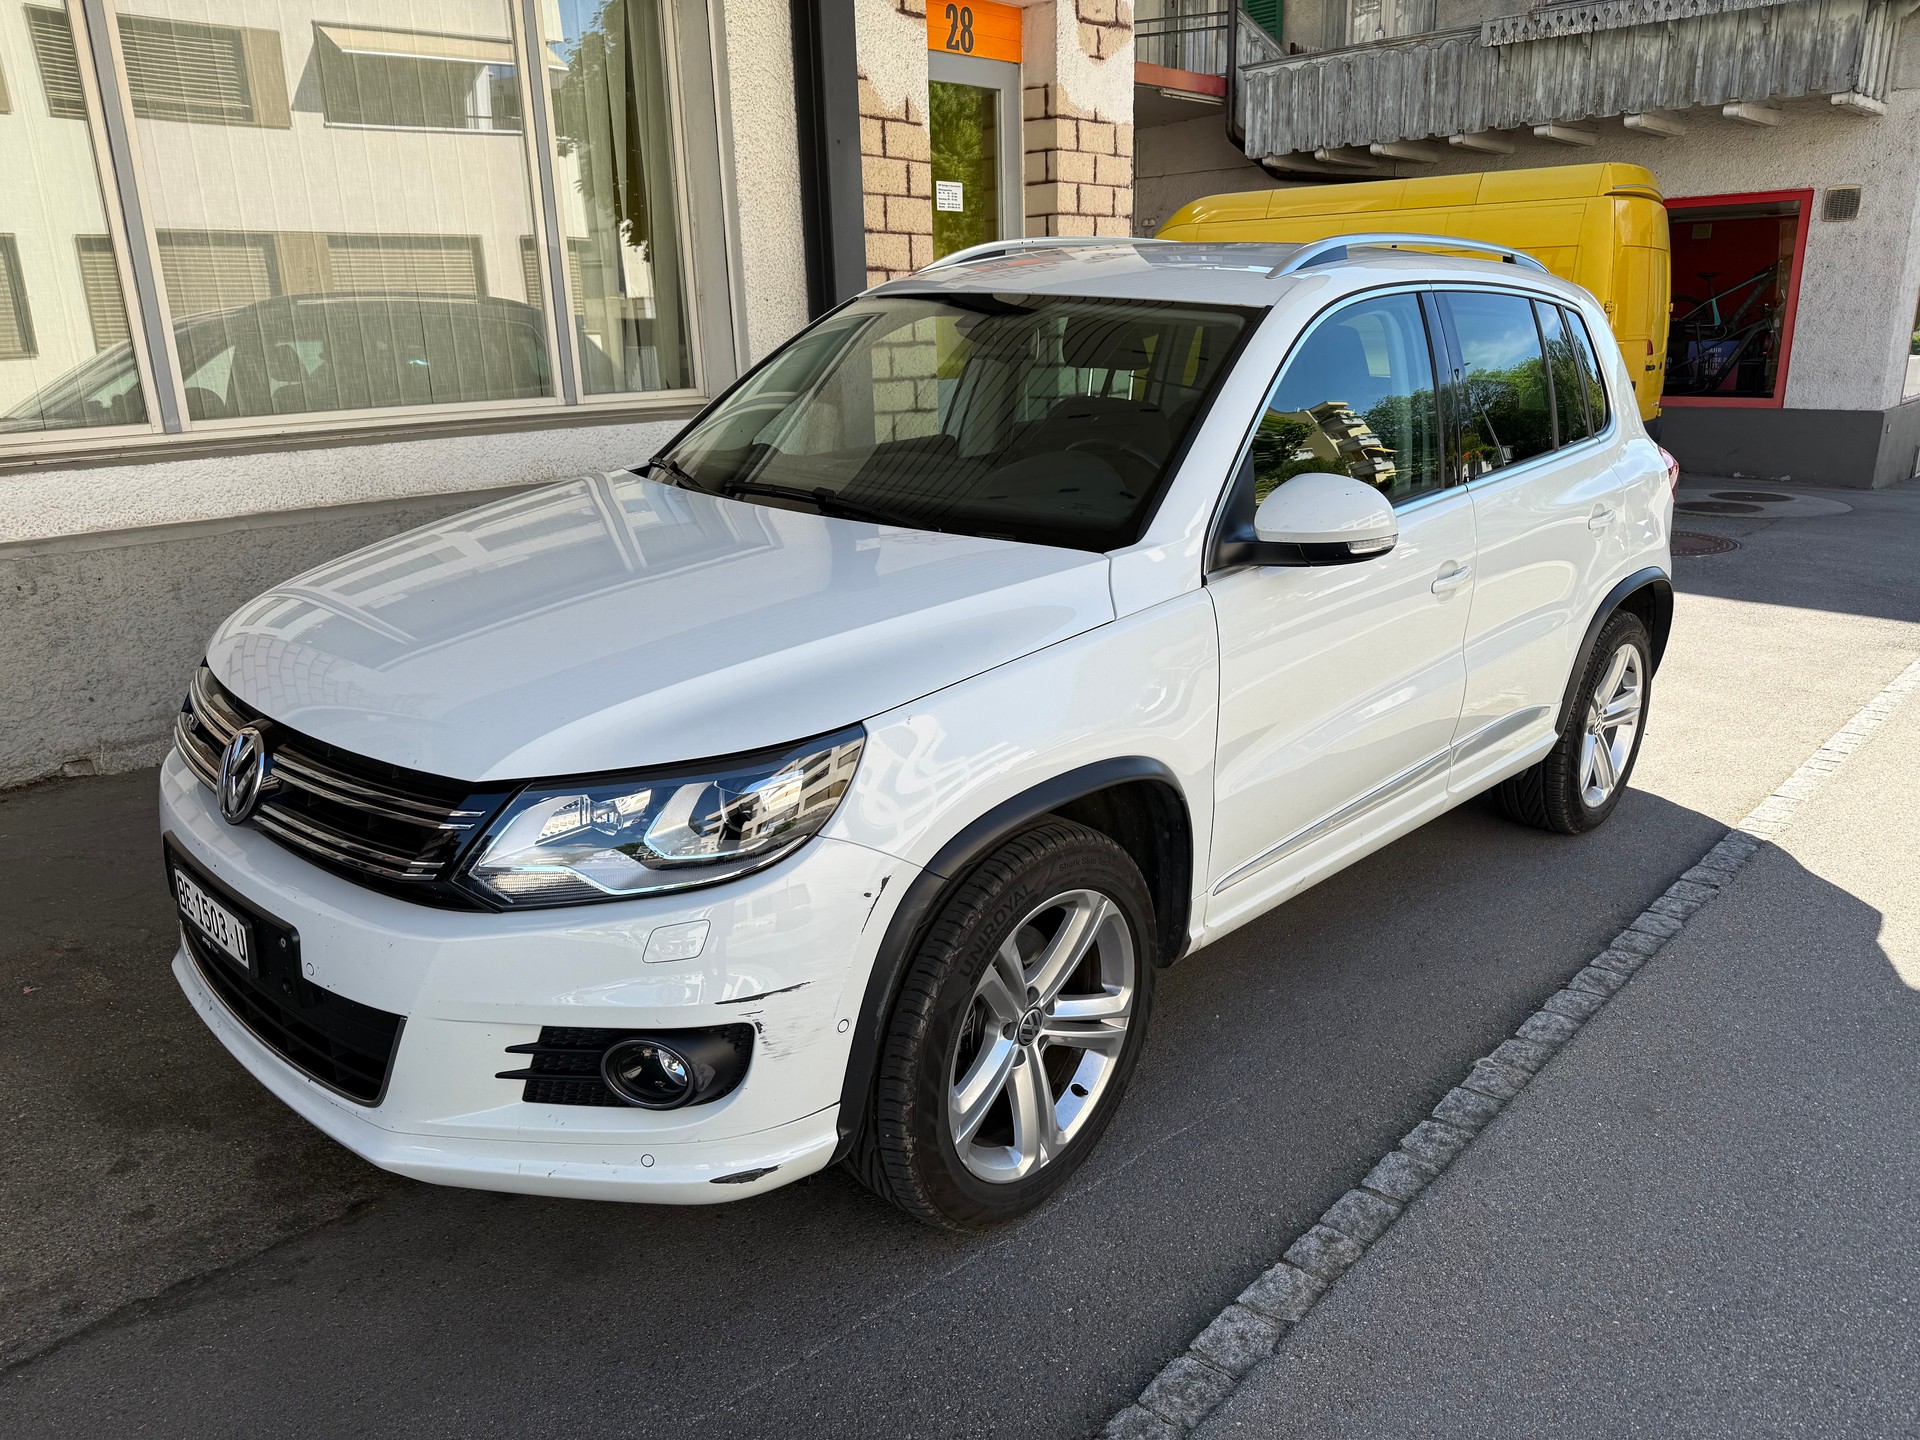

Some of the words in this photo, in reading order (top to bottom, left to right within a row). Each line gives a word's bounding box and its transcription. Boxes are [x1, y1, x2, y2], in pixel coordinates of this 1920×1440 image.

[945, 3, 974, 54] 28
[1059, 859, 1080, 872] Shark
[1081, 857, 1097, 866] Skin
[959, 884, 1034, 977] UNIROYAL
